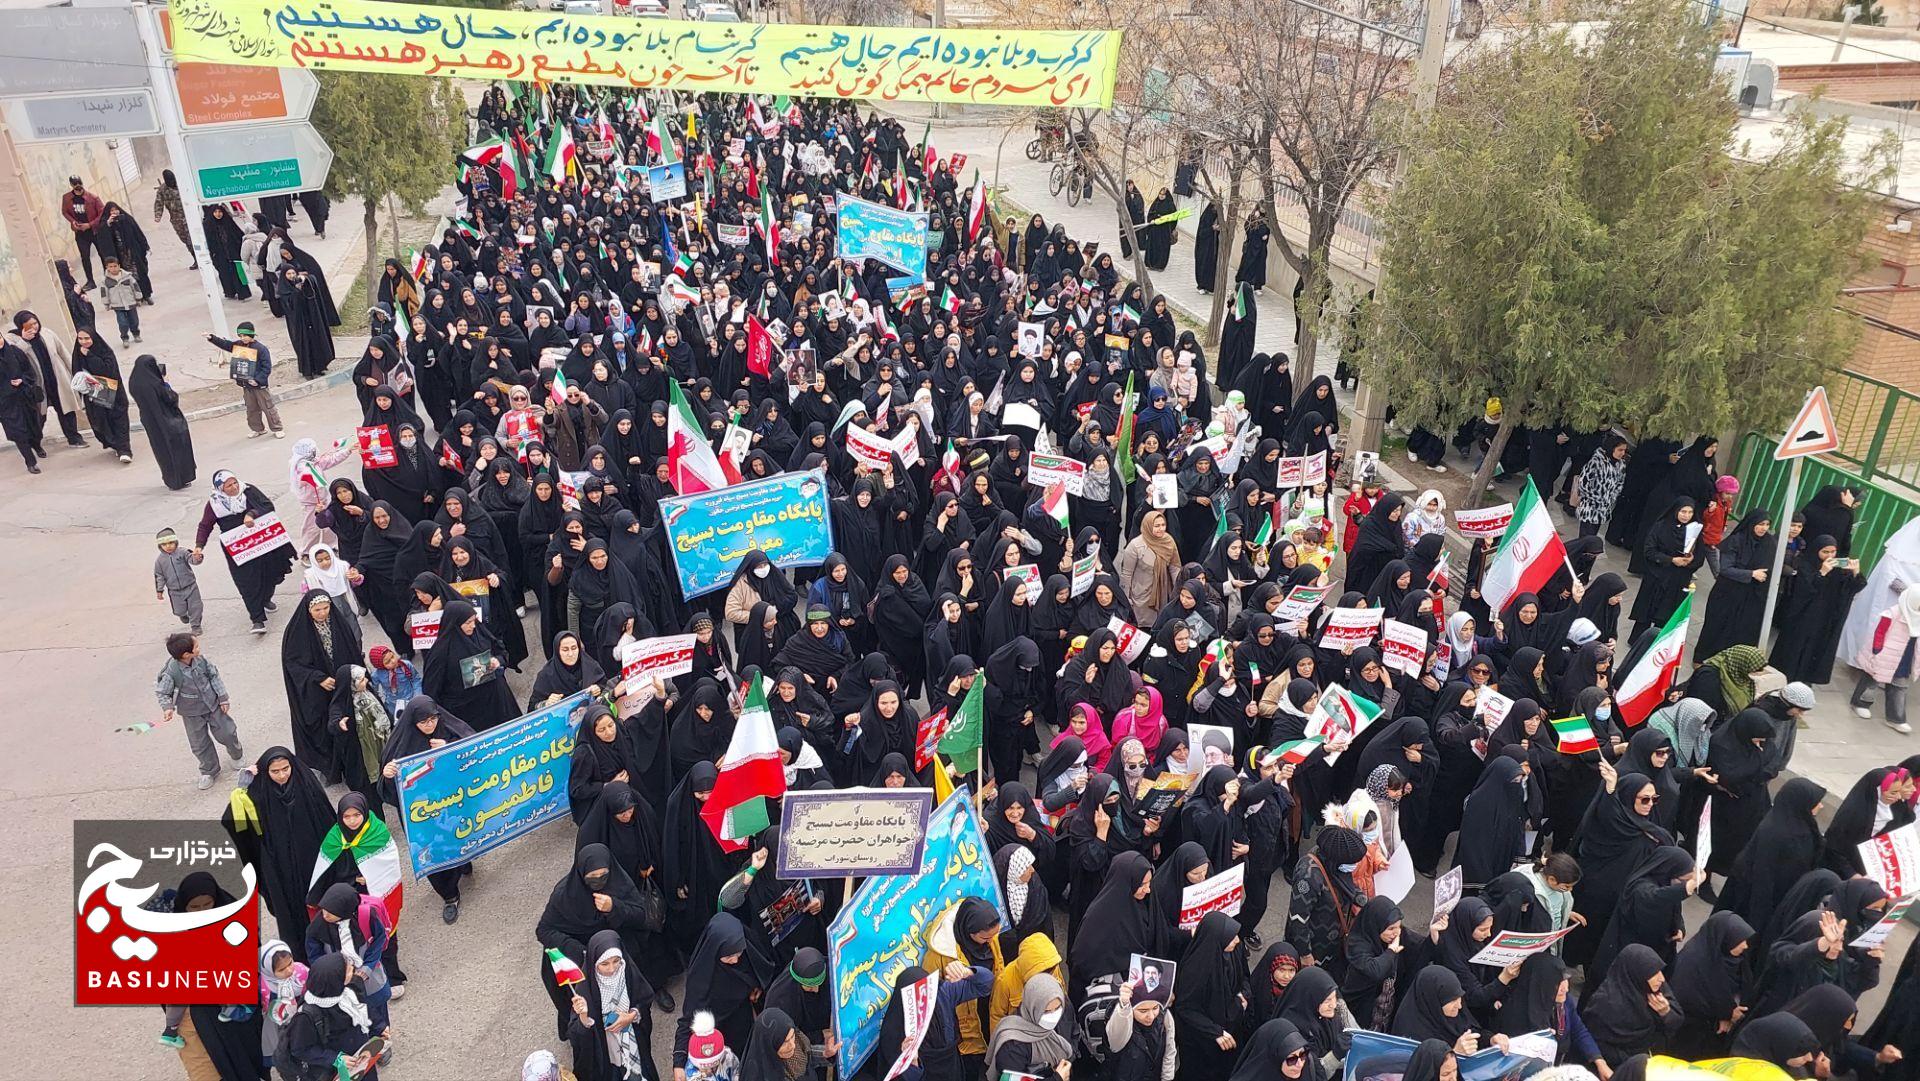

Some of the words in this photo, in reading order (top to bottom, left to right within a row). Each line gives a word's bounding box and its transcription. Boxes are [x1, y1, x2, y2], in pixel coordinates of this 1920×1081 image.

[276, 3, 442, 39] هستیم
[441, 13, 517, 49] حال
[291, 33, 427, 68] هستیم
[573, 22, 642, 51] نبوده
[646, 29, 670, 54] بلا
[674, 28, 740, 58] شام
[842, 33, 896, 67] حال
[424, 50, 526, 79] رهبر
[532, 50, 627, 82] مطیع
[780, 32, 850, 76] هستیم
[1002, 39, 1022, 69] بلا
[629, 55, 684, 87] خون
[676, 56, 756, 86] آخر
[789, 56, 841, 95] کنید
[836, 58, 893, 97] گوش
[882, 60, 932, 100] همگی
[925, 67, 973, 100] عالم
[202, 91, 236, 108] فولاد
[240, 91, 280, 107] مجتمع
[971, 74, 1057, 102] مردم
[1050, 73, 1091, 105] ای
[82, 100, 114, 114] شهدا
[188, 113, 211, 123] Steel
[213, 110, 253, 121] Complex
[37, 125, 69, 136] Martyrs
[70, 123, 107, 135] Cemetery
[230, 166, 260, 180] مشهد
[270, 162, 296, 177] نیشابور
[255, 180, 290, 190] mashhad
[716, 511, 776, 536] مقاومت
[778, 501, 824, 523] پایگاه
[235, 550, 256, 560] DOWN
[256, 543, 272, 552] WITH
[676, 525, 715, 553] بسیج
[718, 535, 784, 563] معرفت
[666, 661, 690, 674] ISRAEL
[670, 651, 692, 661] مرگ
[540, 728, 580, 768] ایگاه
[466, 753, 538, 798] مقاومت
[409, 785, 465, 824] بسیج
[455, 768, 555, 839] فاطمیون
[526, 799, 558, 822] خواهران
[806, 819, 834, 831] بسیج
[834, 816, 875, 830] مقاومت
[876, 815, 906, 829] پایگاه
[829, 833, 865, 848] حضرت
[866, 833, 911, 847] خواهران
[850, 854, 878, 863] روستای
[840, 952, 878, 1008] بسیج
[907, 989, 916, 1025] DOWN
